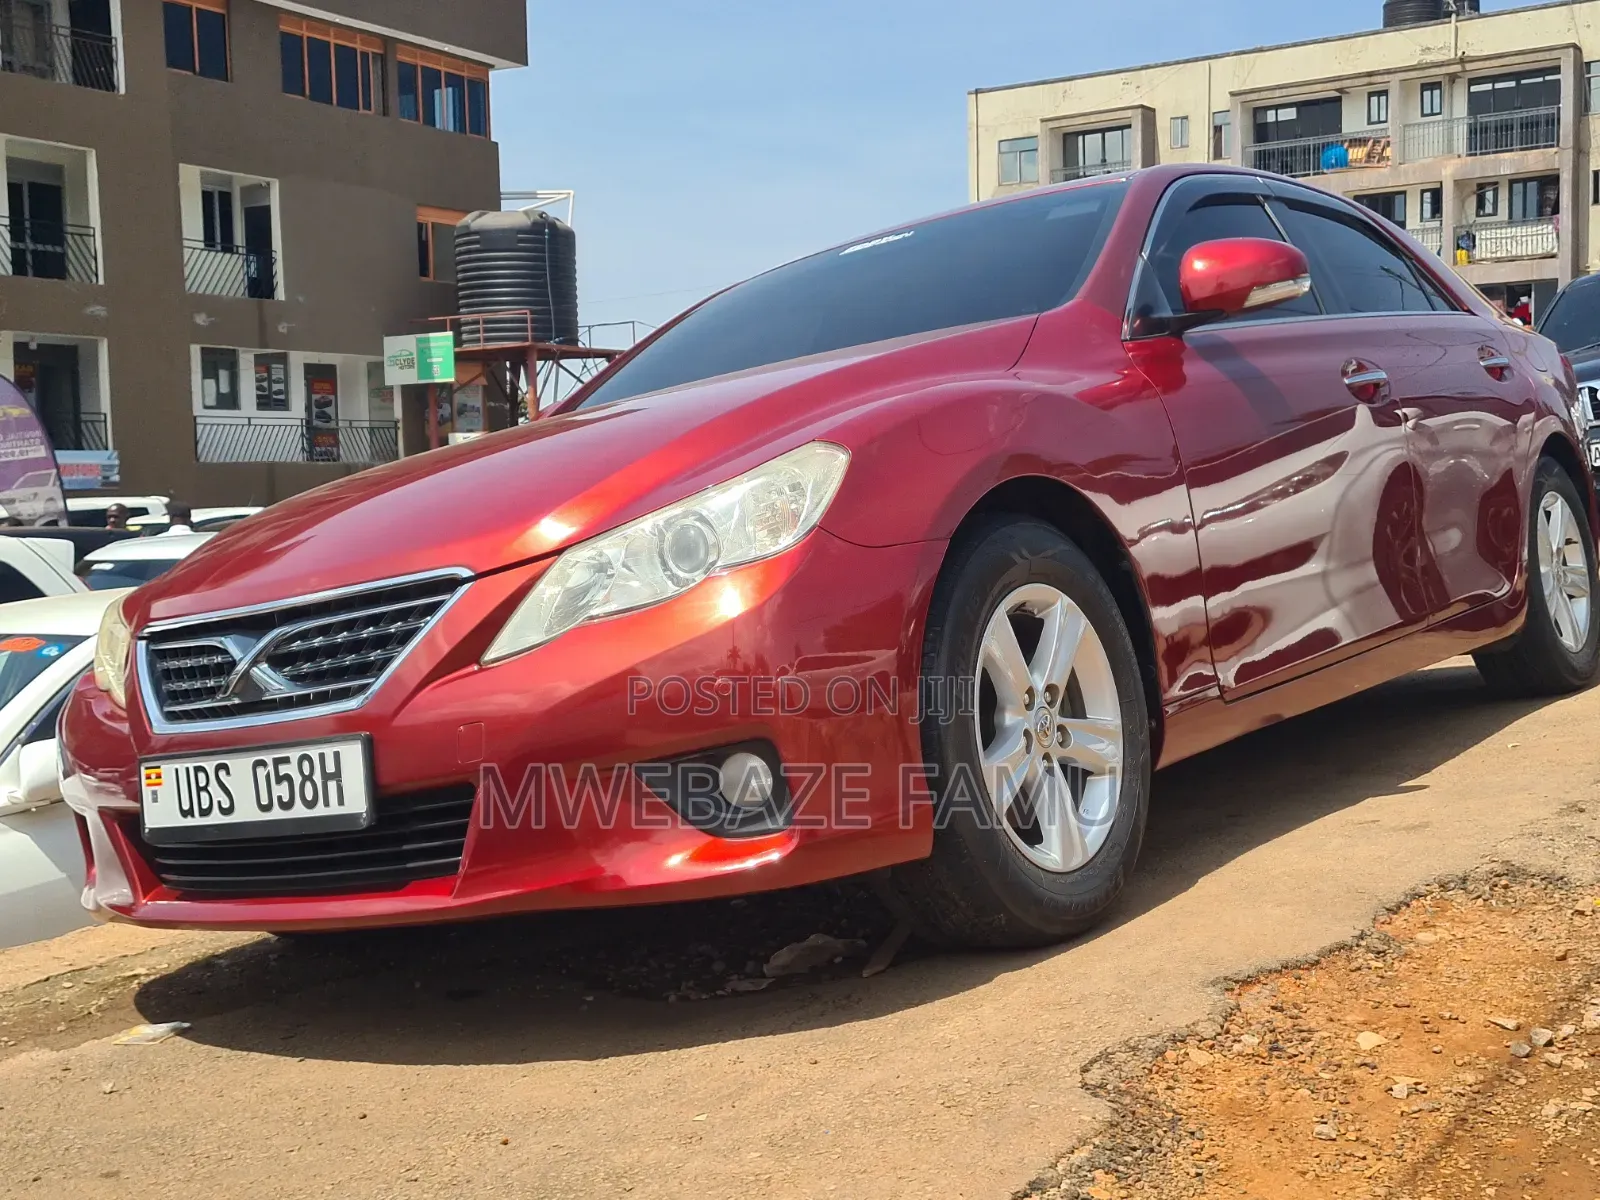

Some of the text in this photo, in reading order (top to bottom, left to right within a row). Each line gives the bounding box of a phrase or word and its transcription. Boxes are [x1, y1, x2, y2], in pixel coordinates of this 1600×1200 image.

[395, 357, 415, 366] CLYDE
[174, 750, 345, 819] UBS 058H
